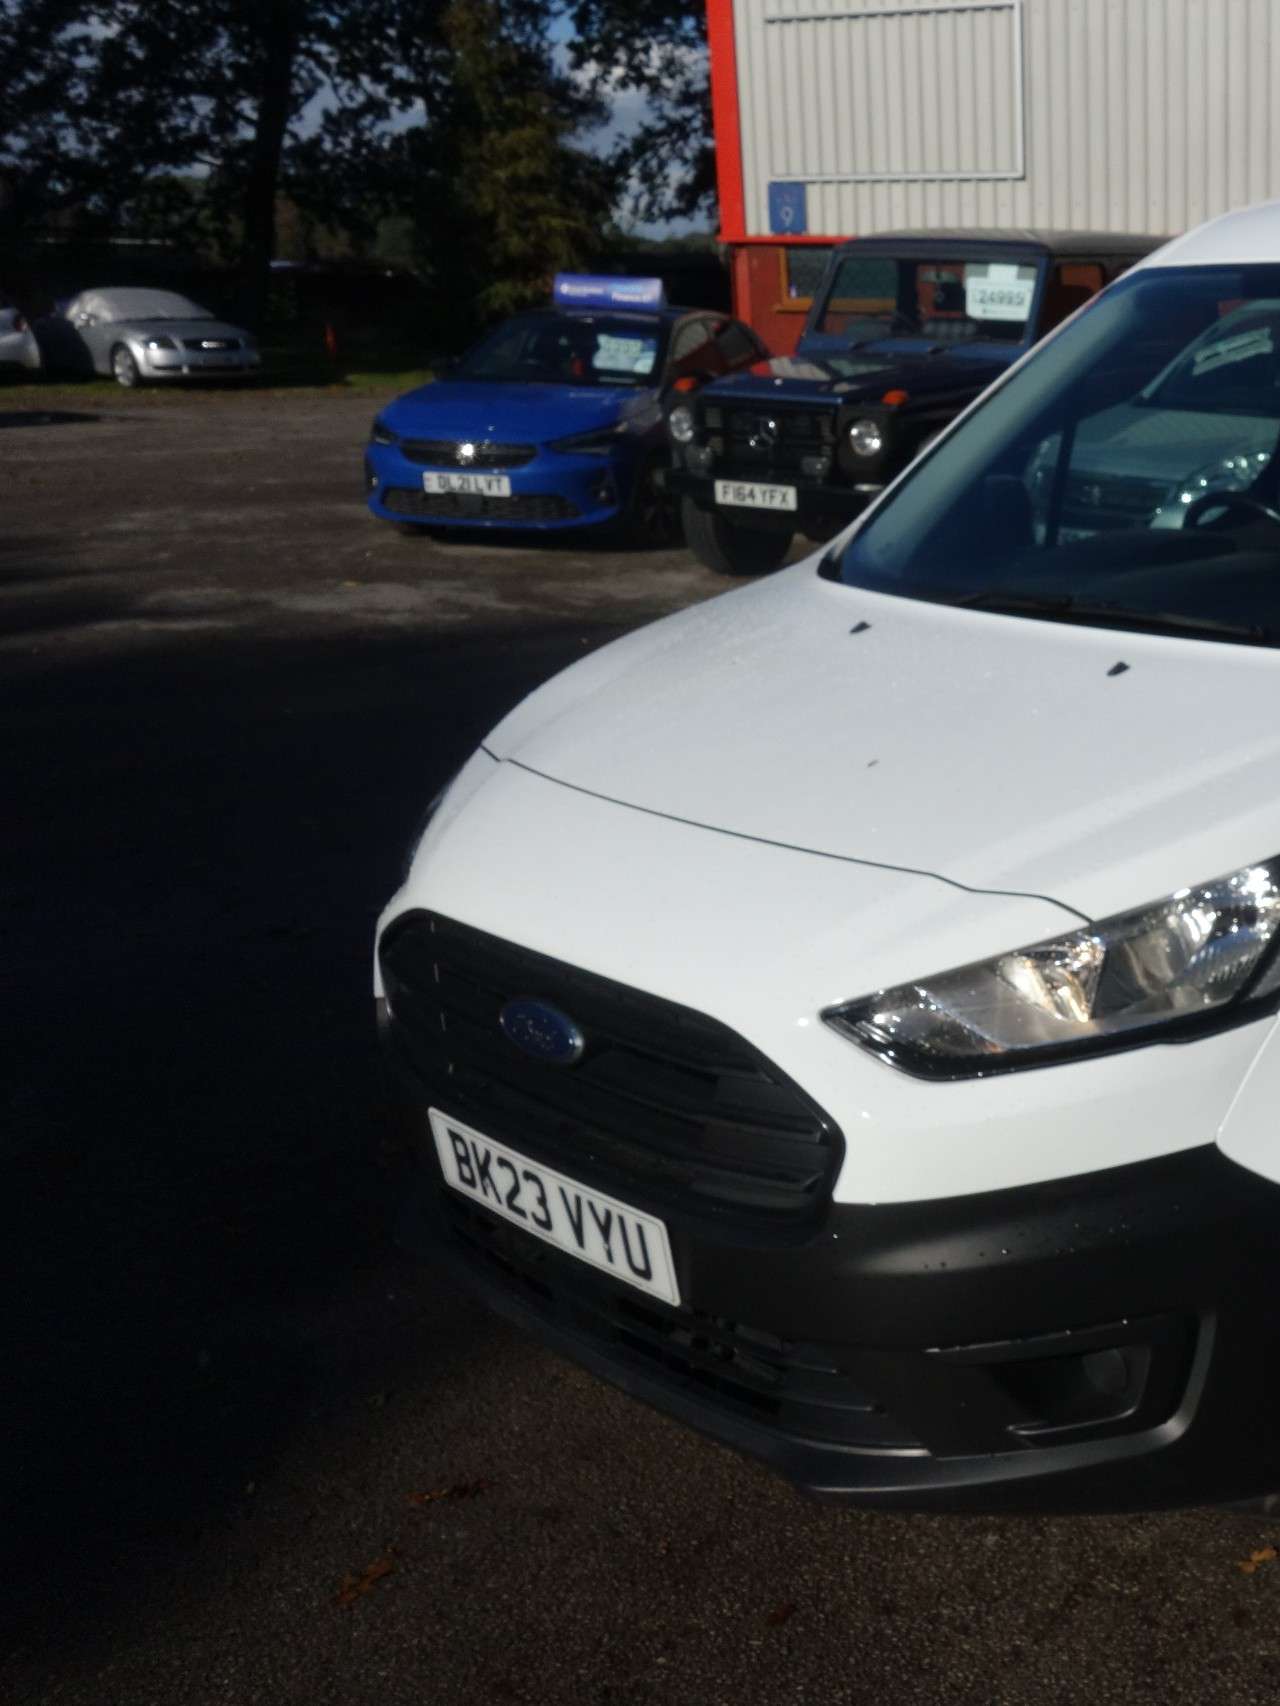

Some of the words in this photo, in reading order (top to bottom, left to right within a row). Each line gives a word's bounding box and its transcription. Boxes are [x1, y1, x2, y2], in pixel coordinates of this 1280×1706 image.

[722, 484, 756, 503] F164
[761, 487, 789, 506] YFX
[447, 1129, 553, 1231] BK23
[559, 1185, 652, 1281] VYU
